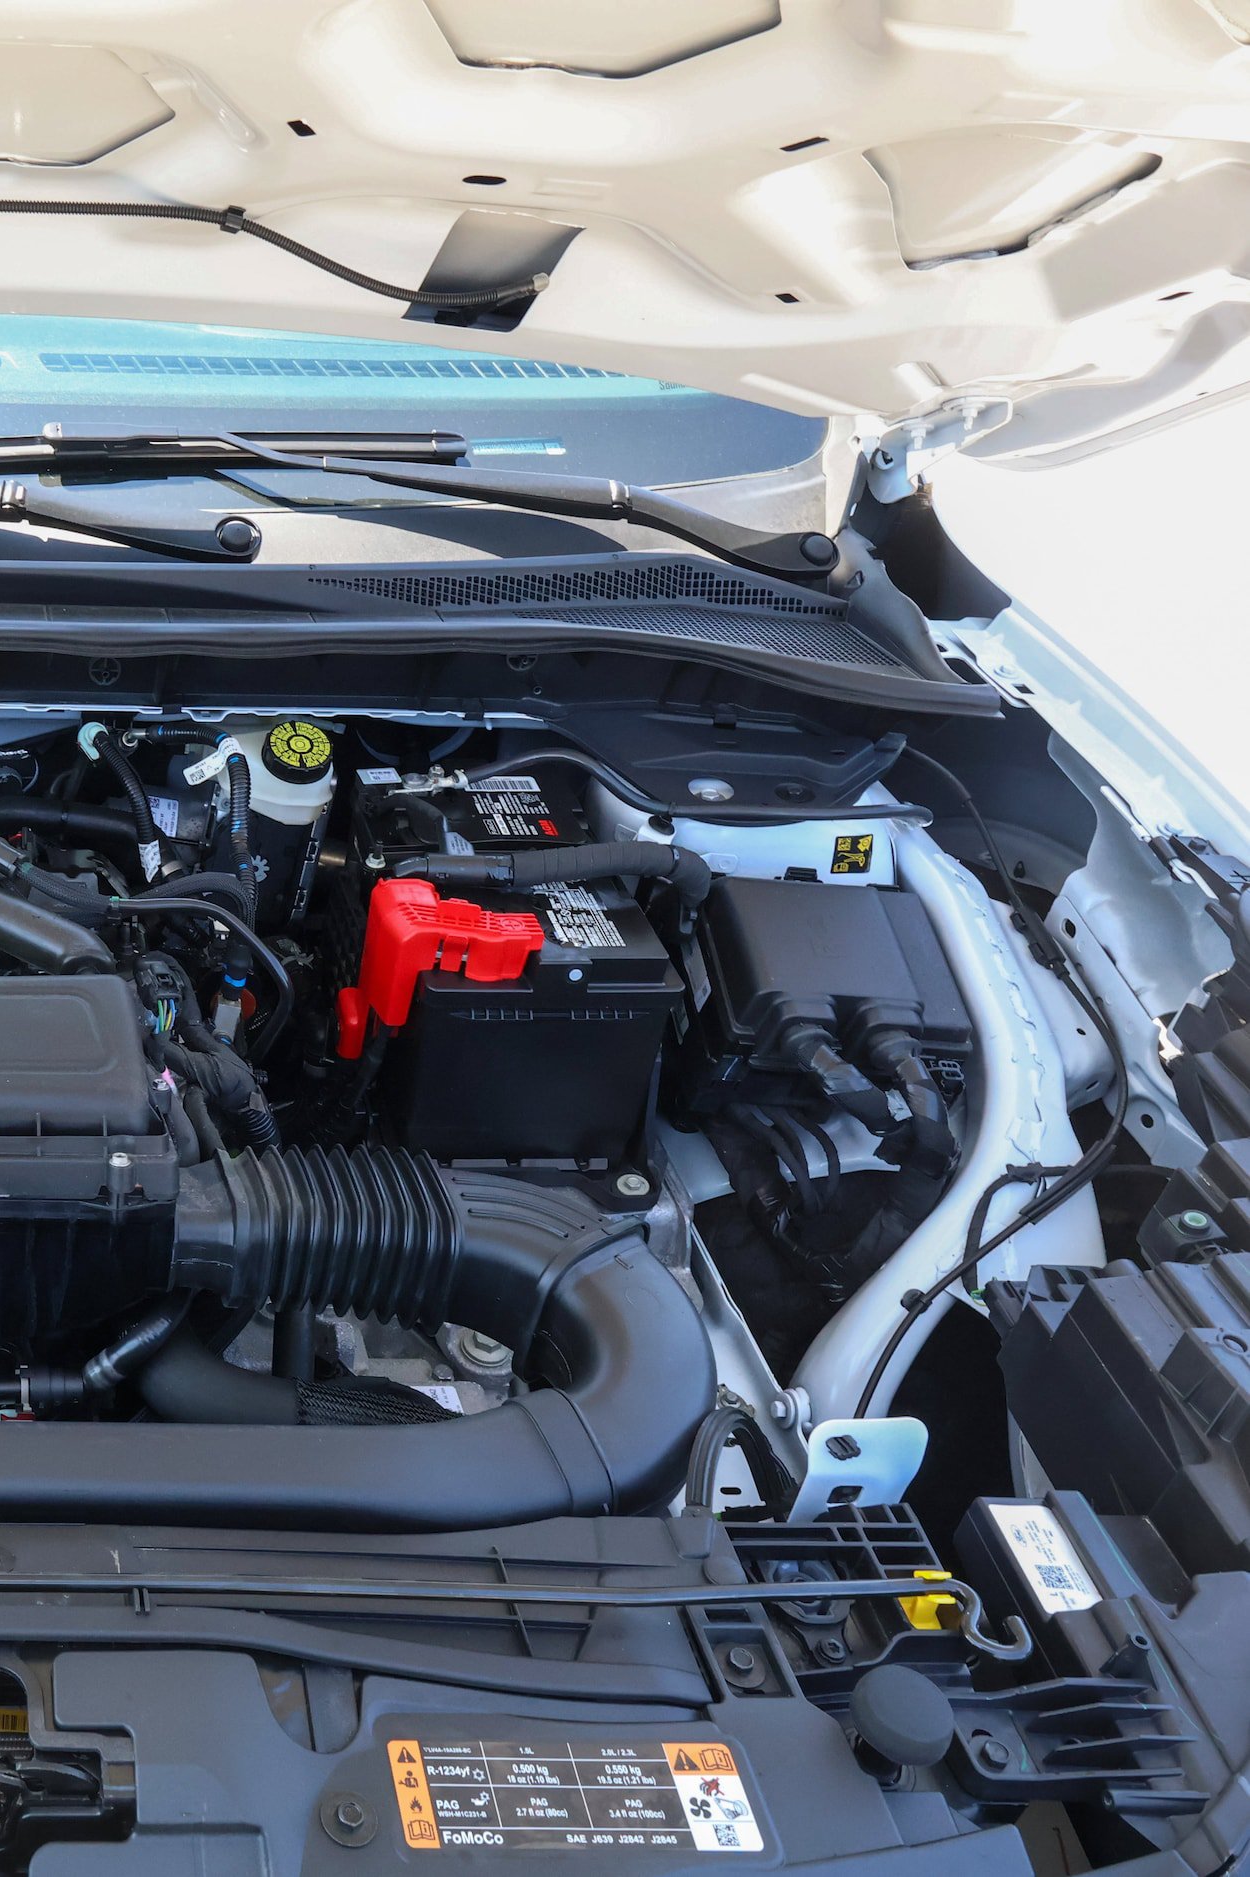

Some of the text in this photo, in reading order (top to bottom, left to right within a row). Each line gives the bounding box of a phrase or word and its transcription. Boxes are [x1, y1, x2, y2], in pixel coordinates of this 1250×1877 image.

[426, 1765, 470, 1778] R-1234yf
[512, 1764, 549, 1776] 0.500 kg
[605, 1765, 642, 1776] 0.550 kg
[507, 1775, 516, 1783] 18
[527, 1775, 545, 1785] (1.10
[545, 1775, 560, 1785] lbs)
[597, 1776, 612, 1784] 19.5
[623, 1776, 640, 1785] (1.21
[641, 1776, 656, 1786] lbs)
[436, 1800, 460, 1810] PAG
[530, 1798, 548, 1806] PAG
[624, 1799, 643, 1808] PAG
[516, 1808, 527, 1816] 2.7
[609, 1809, 621, 1818] 3.4
[638, 1810, 666, 1820] (100cc)
[442, 1831, 504, 1845] FoMoCo
[566, 1834, 678, 1845] SAE J639 J2842 J2845
